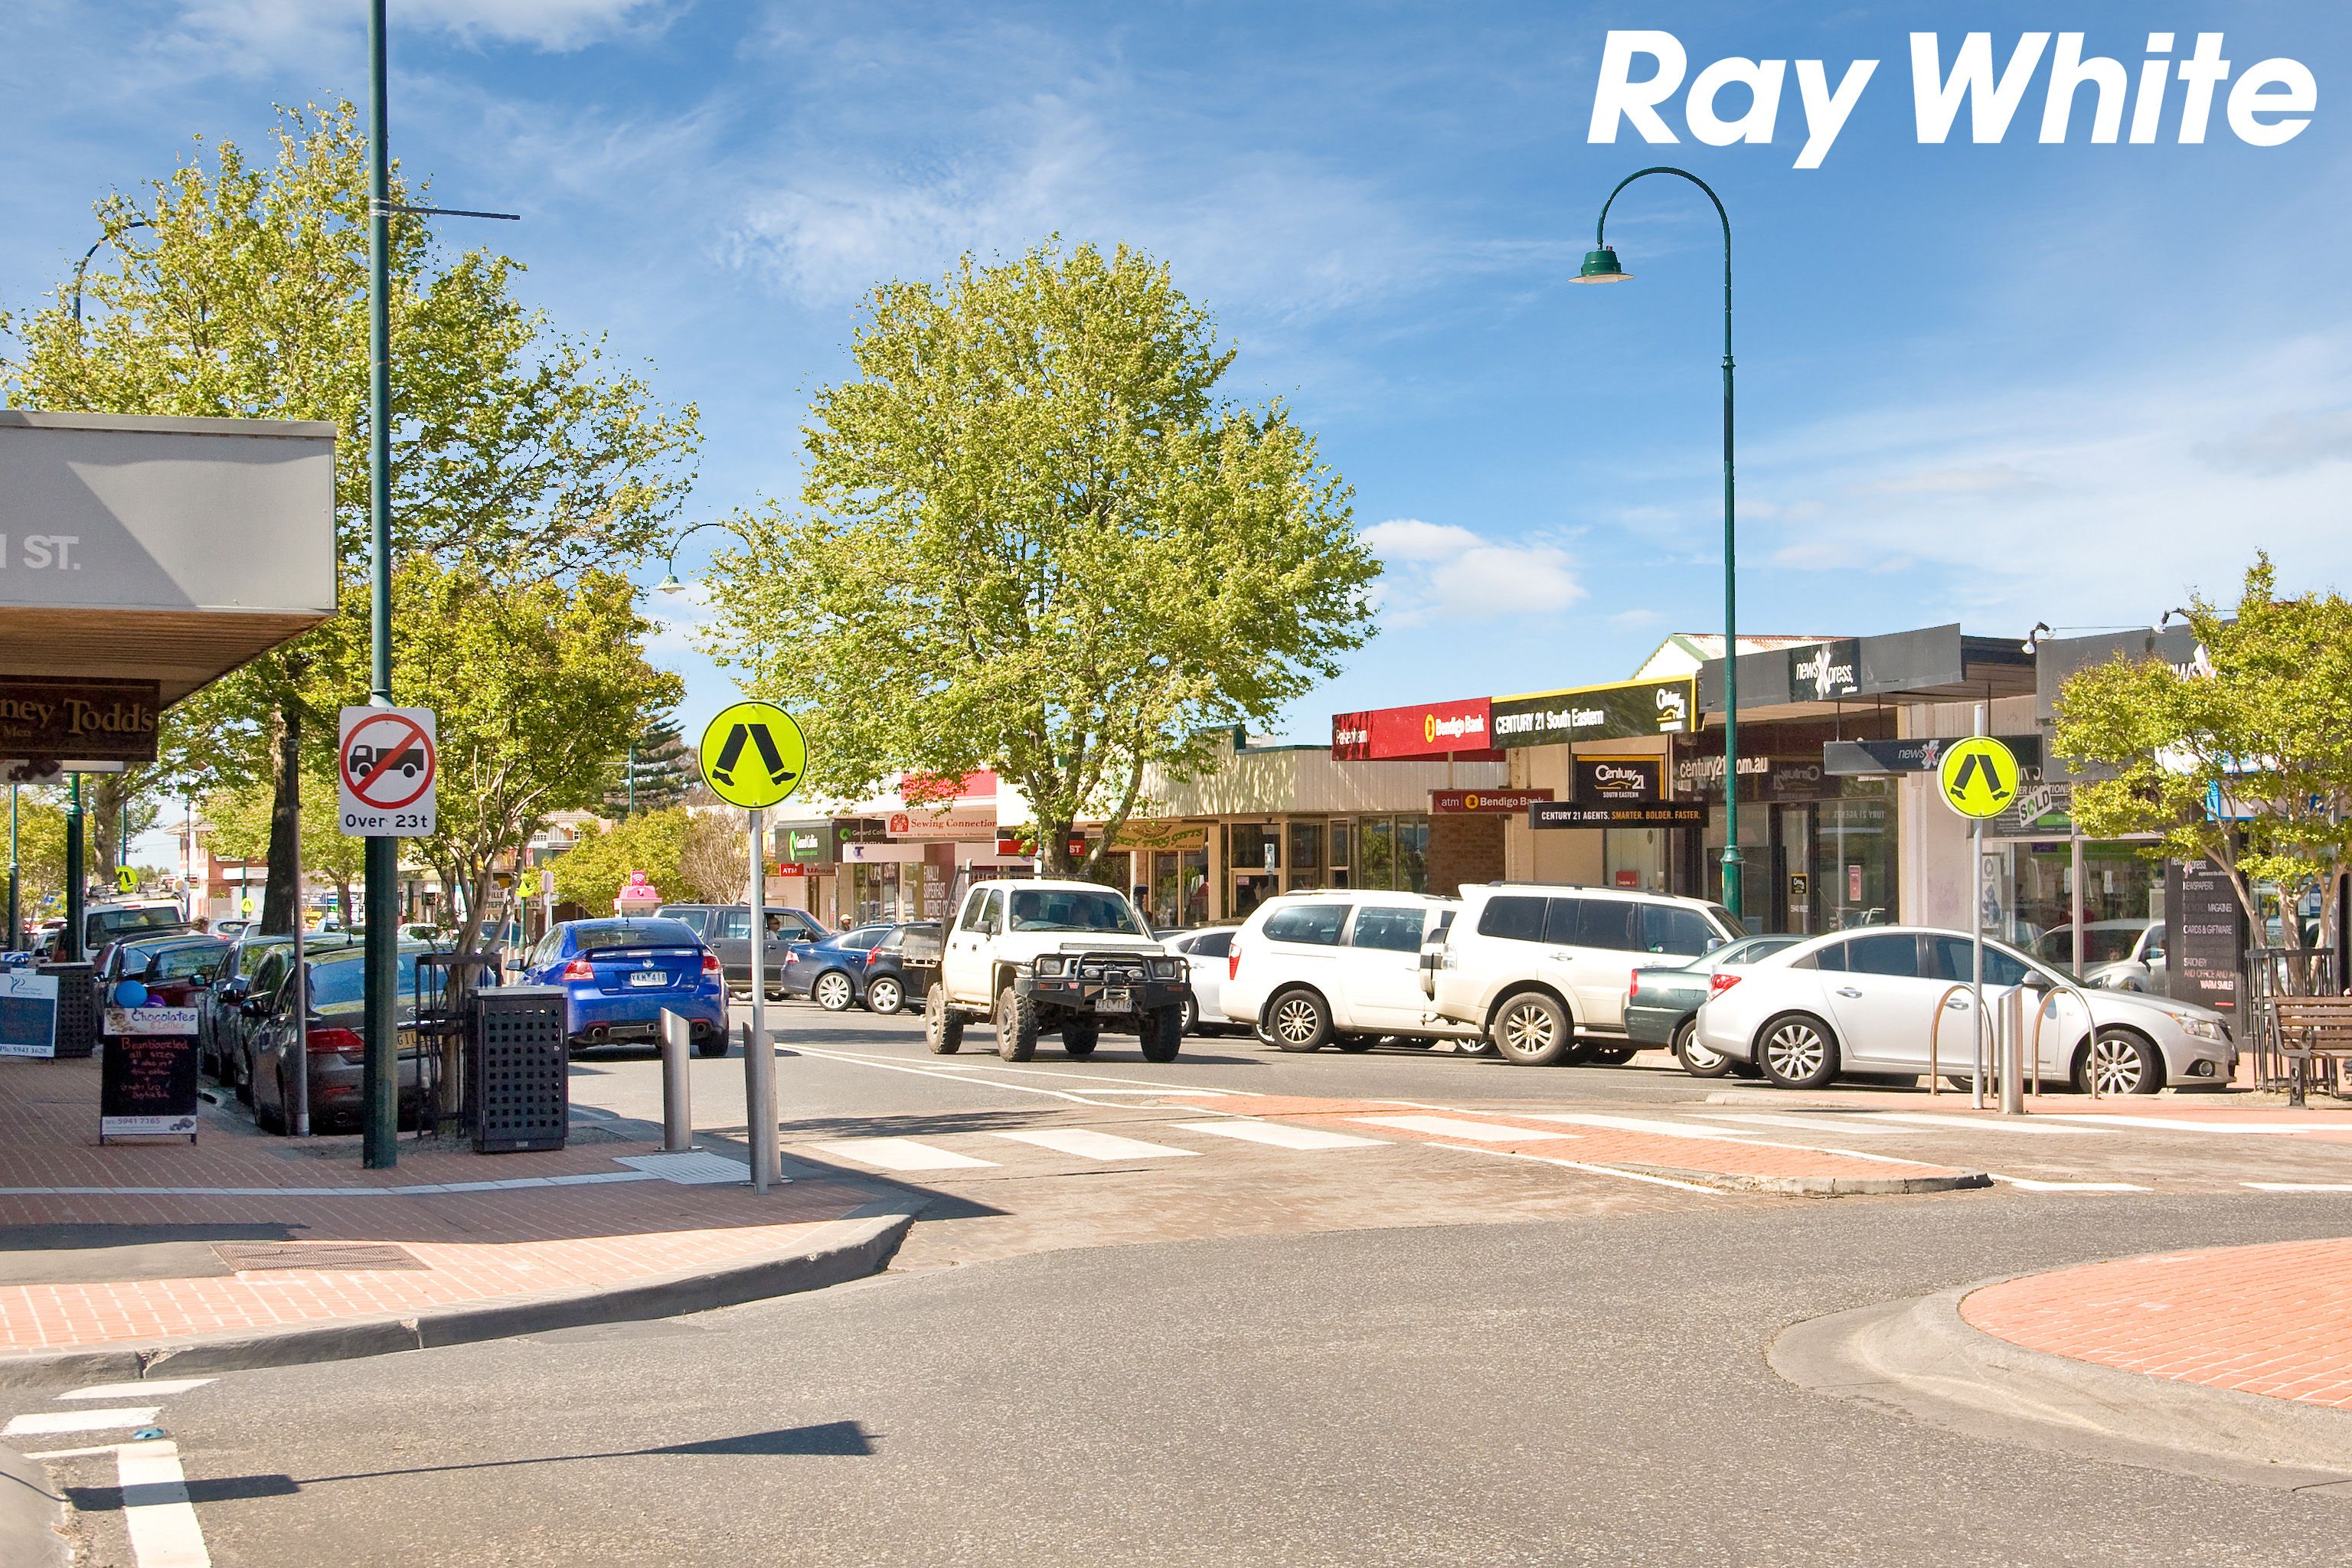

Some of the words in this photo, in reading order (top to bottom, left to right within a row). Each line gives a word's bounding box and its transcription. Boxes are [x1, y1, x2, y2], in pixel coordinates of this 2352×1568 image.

[23, 534, 81, 570] ST.
[64, 697, 155, 735] Todd's
[1495, 712, 1535, 735] CENTURY
[1535, 711, 1545, 731] 21
[1547, 709, 1571, 730] South
[1572, 707, 1604, 727] Eastern
[1435, 715, 1465, 739] Bendigo
[1465, 714, 1485, 733] Bank
[1335, 727, 1367, 746] Pakenham
[1596, 764, 1636, 782] Century
[1632, 774, 1645, 790] 21
[1441, 797, 1459, 807] atm
[1480, 796, 1518, 808] Bendigo
[345, 814, 386, 828] Over
[395, 814, 428, 828] 23t
[911, 818, 944, 829] Sewing
[1541, 811, 1572, 821] CENTURY
[1573, 811, 1582, 820] 21
[1583, 811, 1610, 820] AGENTS.
[1611, 810, 1645, 820] SMARTER.
[1645, 810, 1674, 819] BOLDER.
[1674, 810, 1701, 819] FASTER.
[2200, 980, 2217, 989] WARM
[132, 1010, 196, 1022] Chocolates
